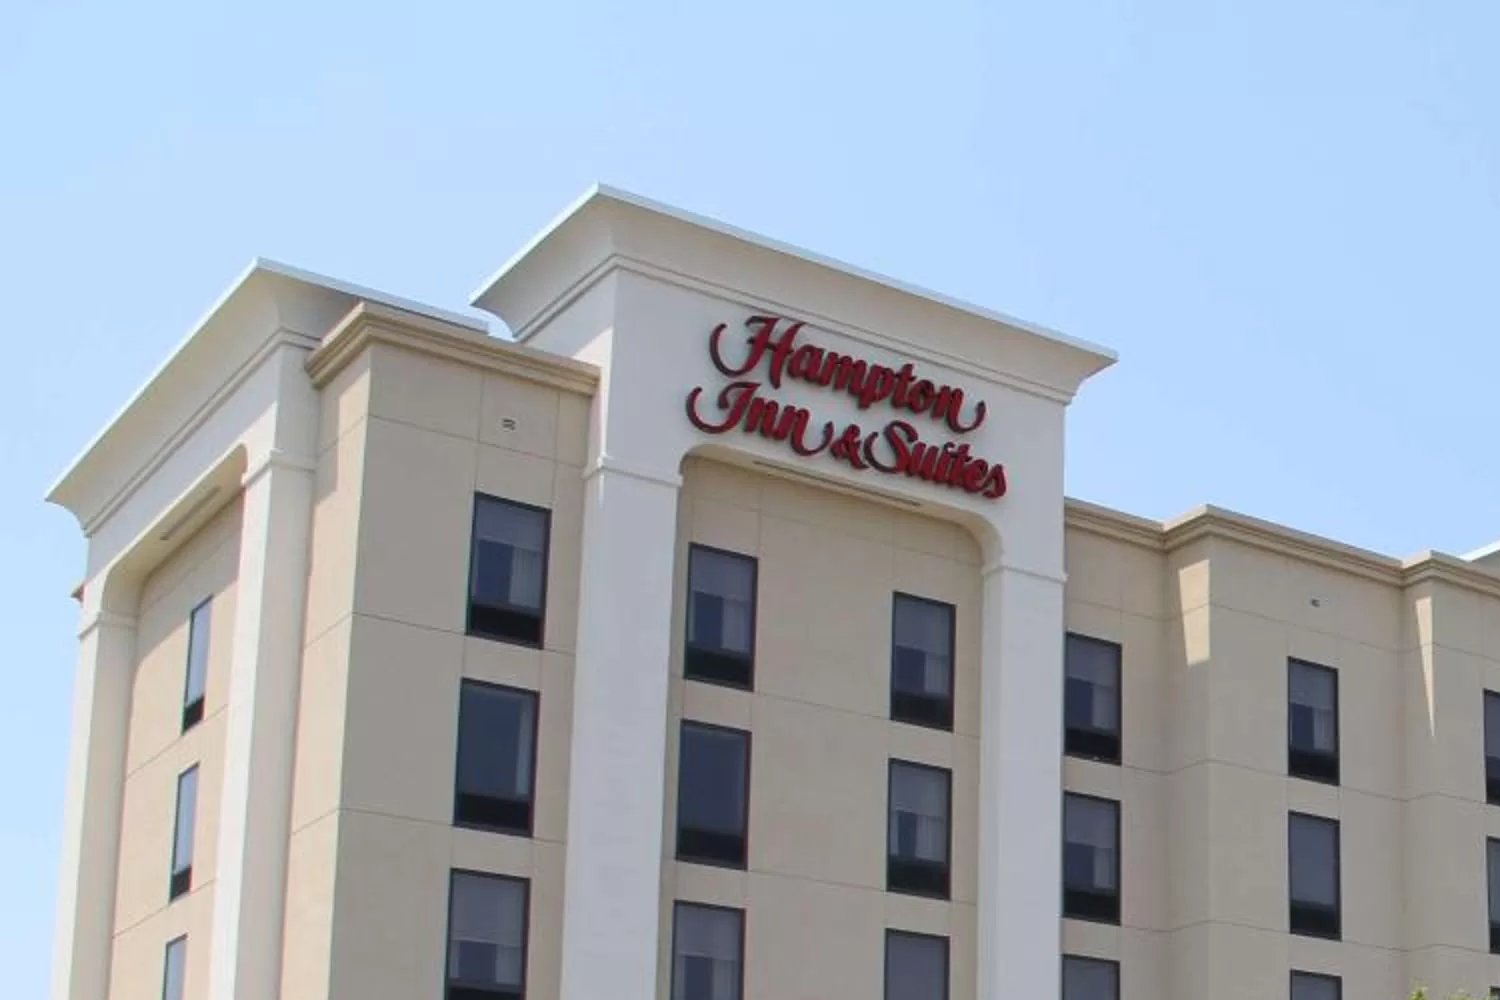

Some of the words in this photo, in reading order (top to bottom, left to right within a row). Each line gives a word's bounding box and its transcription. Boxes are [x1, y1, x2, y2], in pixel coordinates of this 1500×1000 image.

[709, 315, 986, 433] Hampton
[686, 381, 834, 456] Inn
[830, 424, 869, 469] &
[864, 420, 1007, 499] Suites
